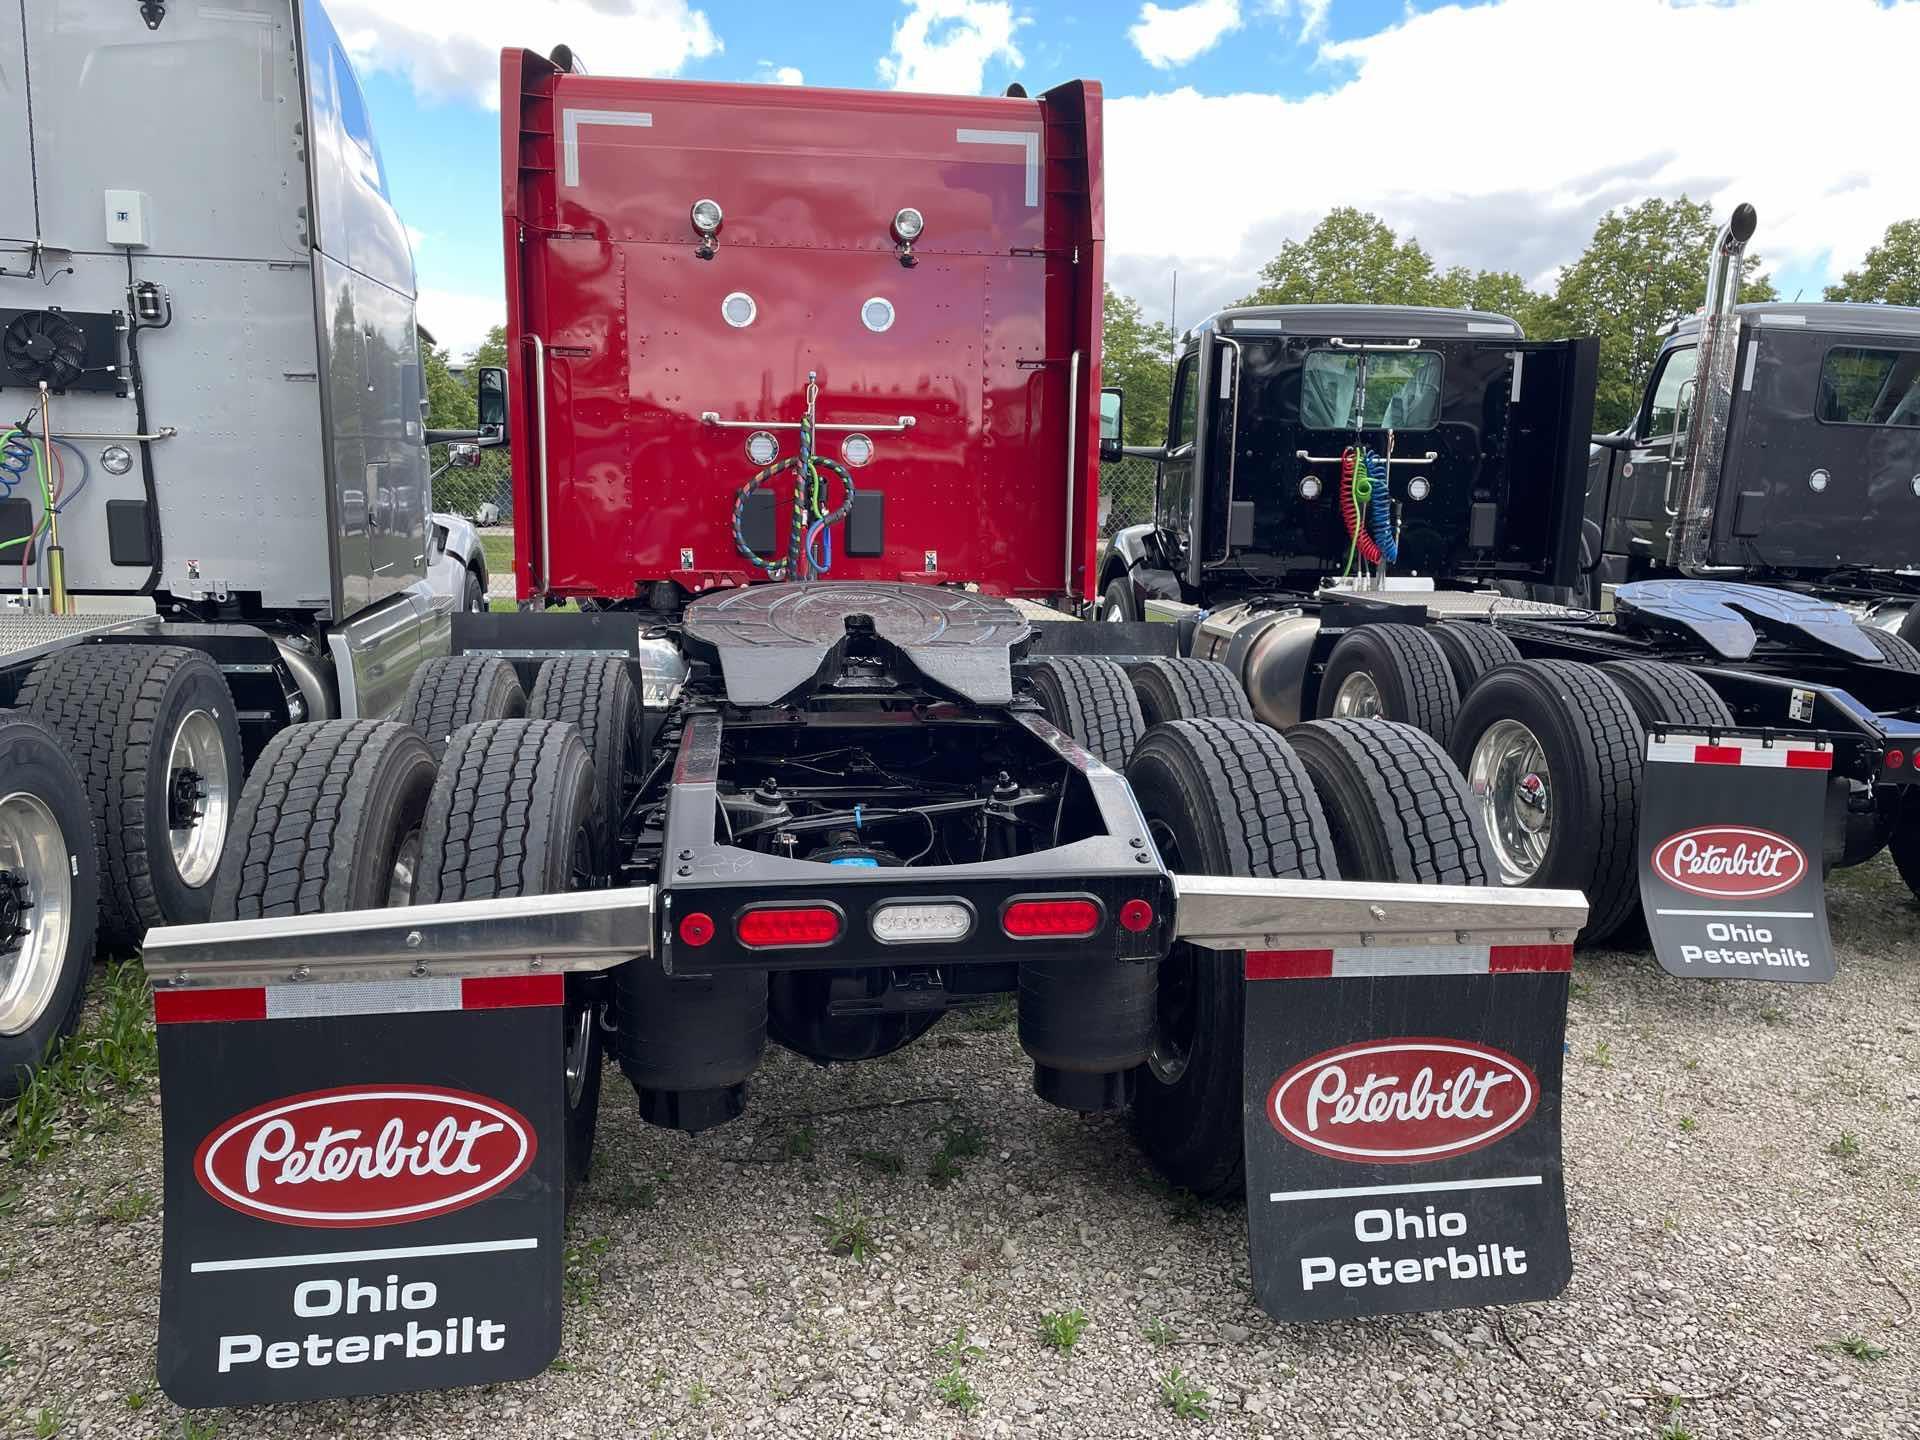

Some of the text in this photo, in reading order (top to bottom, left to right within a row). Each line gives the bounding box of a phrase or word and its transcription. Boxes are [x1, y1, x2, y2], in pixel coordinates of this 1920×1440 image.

[1673, 838, 1793, 878] Peterbilt
[1705, 922, 1773, 944] Ohio
[1679, 944, 1811, 968] Peterbilt
[1306, 1065, 1513, 1132] Peterbilt
[245, 1116, 504, 1193] Peterbilt
[1353, 1205, 1467, 1243] Ohio
[1299, 1243, 1528, 1292] Peterbilt
[293, 1274, 437, 1318] Ohio
[217, 1316, 506, 1374] Peterbilt
